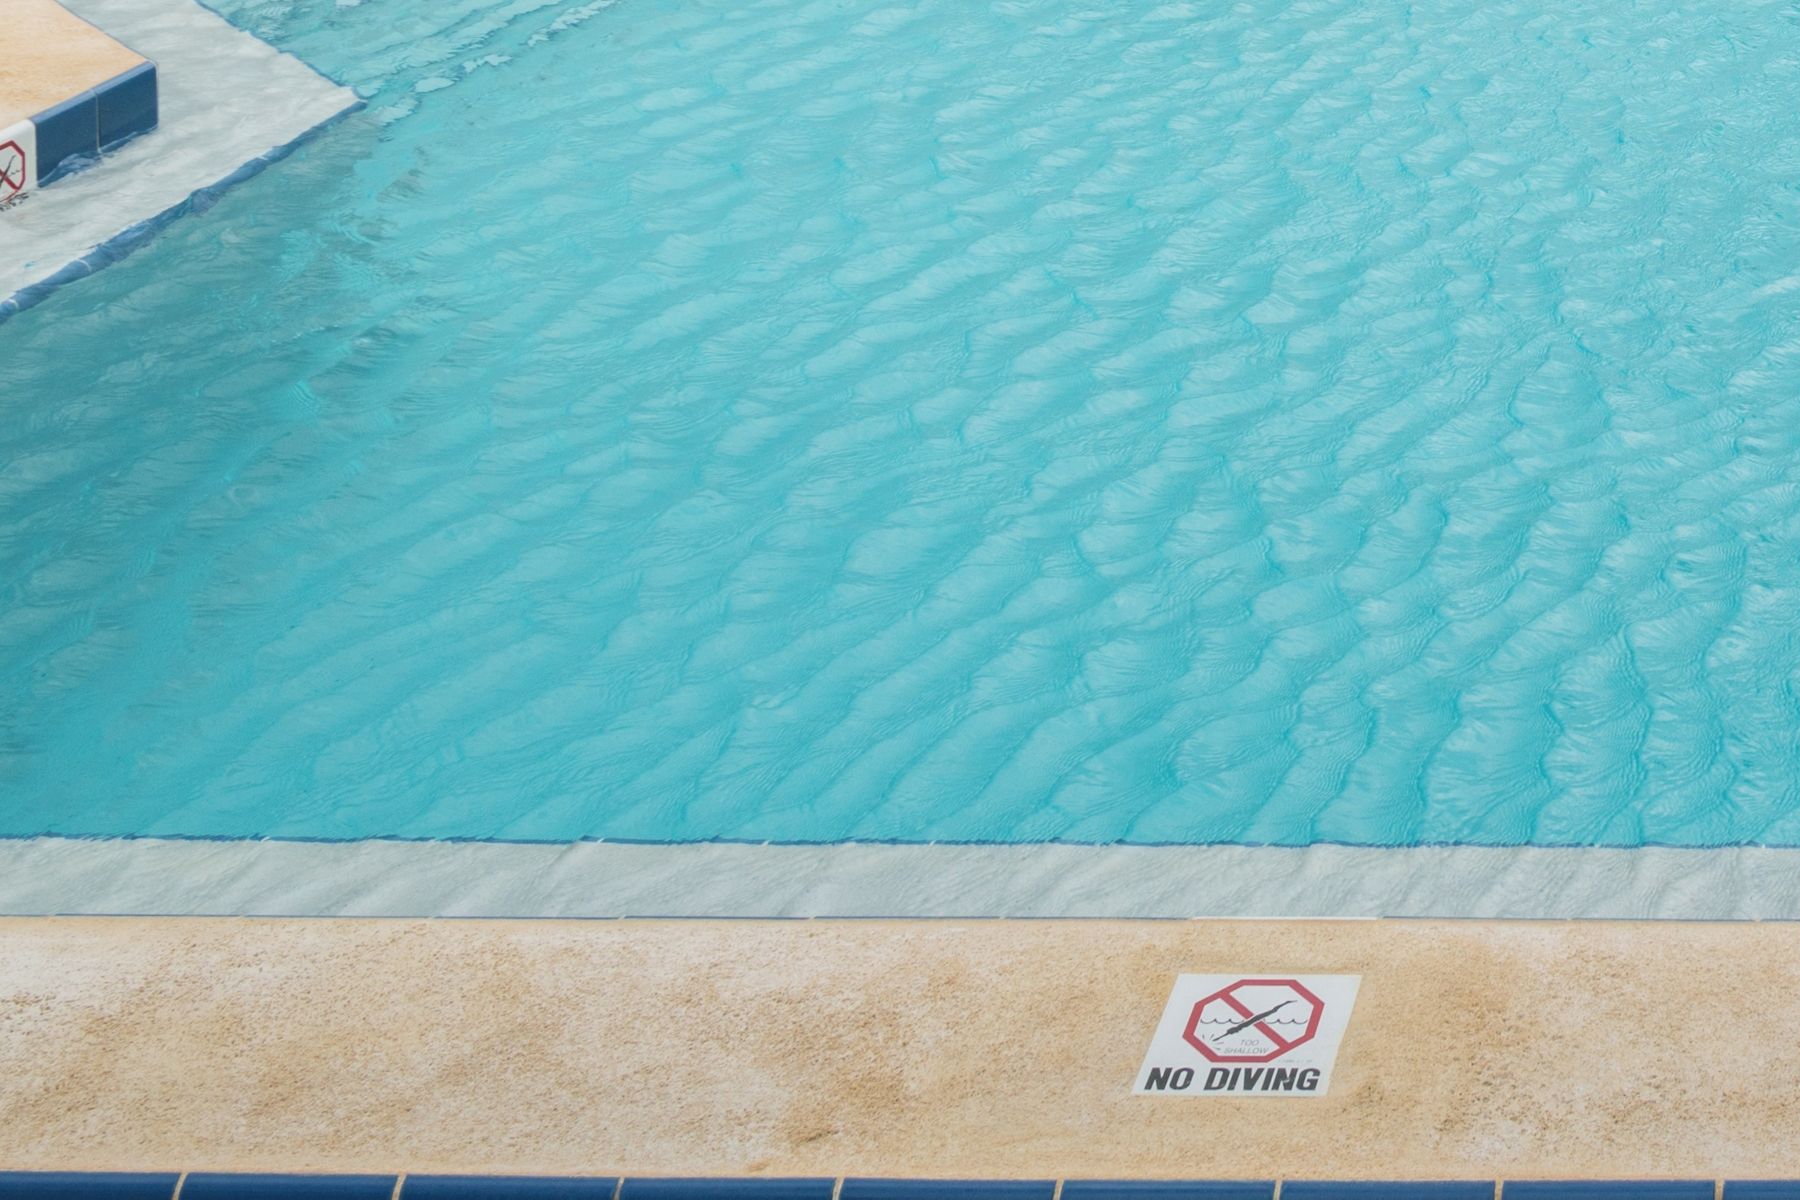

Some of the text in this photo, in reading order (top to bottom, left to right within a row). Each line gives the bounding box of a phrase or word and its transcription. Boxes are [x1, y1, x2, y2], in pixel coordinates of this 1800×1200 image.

[1240, 1038, 1260, 1046] TOO
[1223, 1046, 1270, 1055] SHALLOW
[1144, 1066, 1321, 1092] NO DIVING
